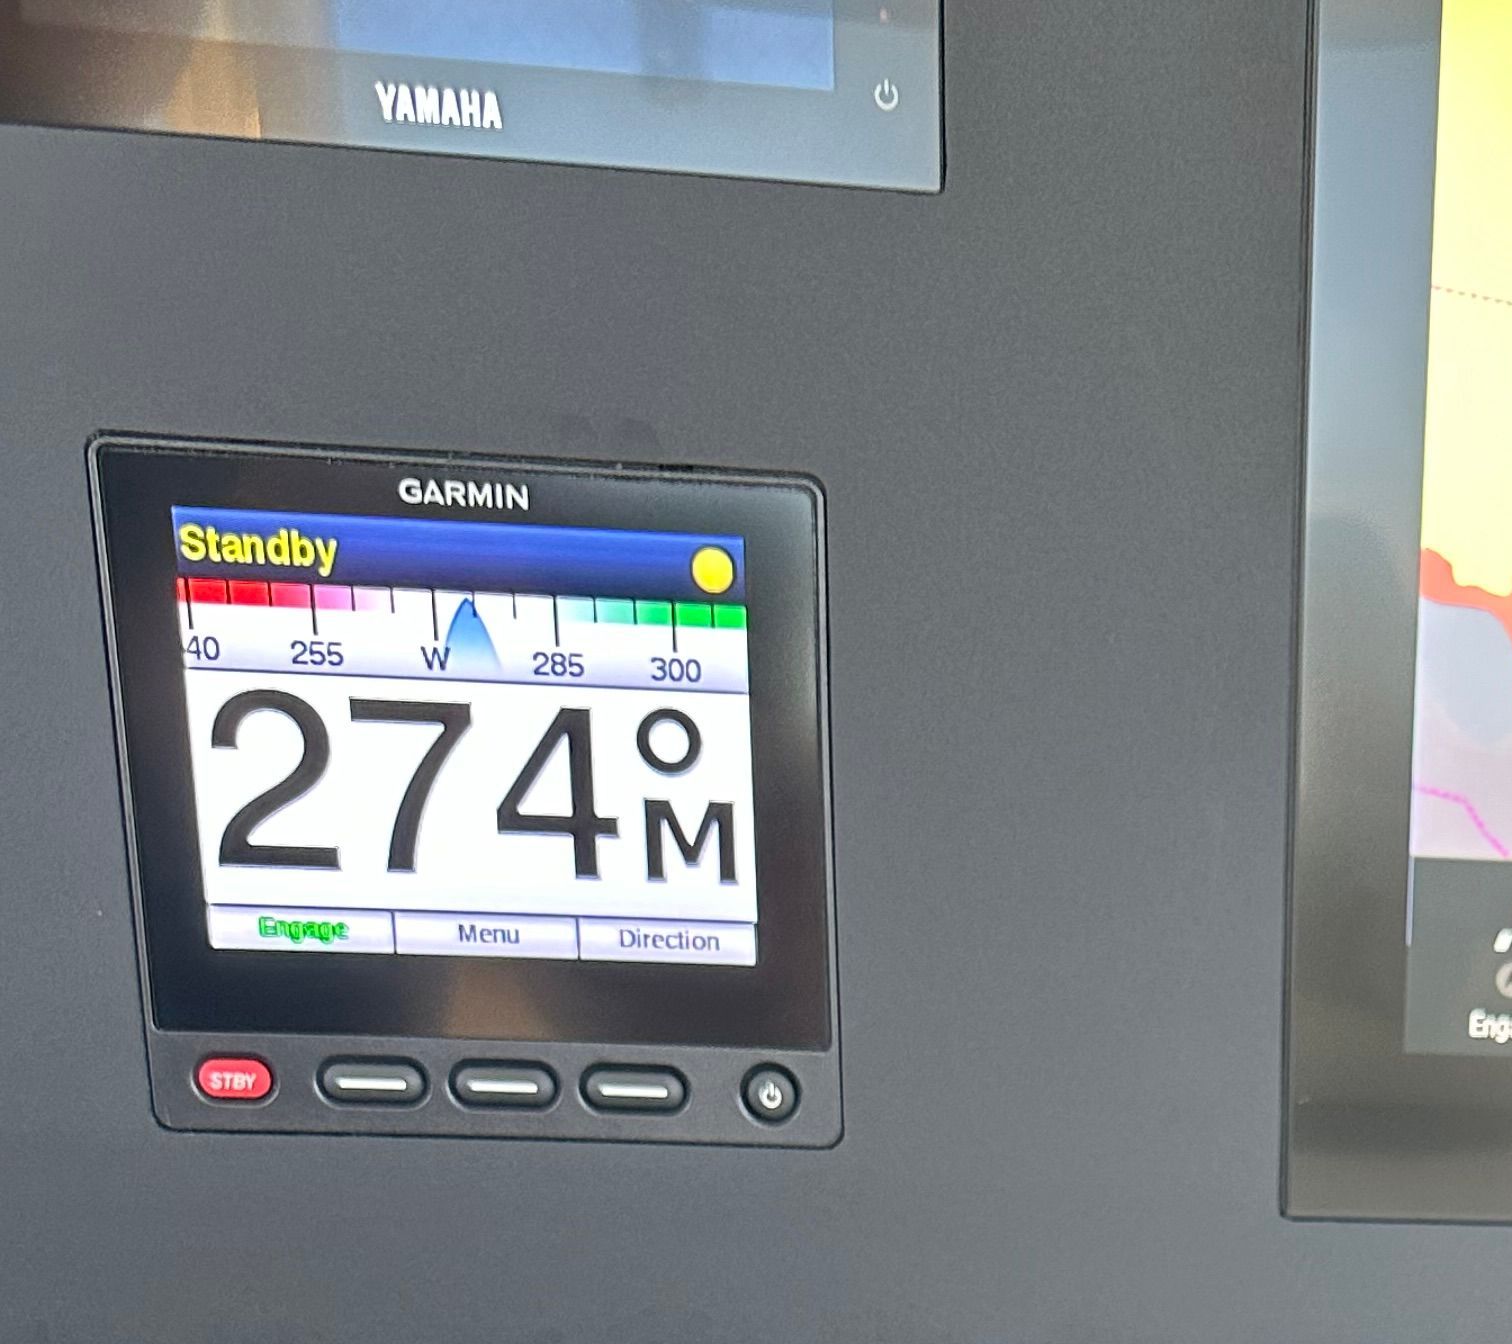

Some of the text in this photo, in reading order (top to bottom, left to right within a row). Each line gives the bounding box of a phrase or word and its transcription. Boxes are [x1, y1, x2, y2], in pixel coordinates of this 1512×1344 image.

[374, 81, 504, 130] YAMAHA
[398, 477, 531, 511] GARMIN
[179, 525, 338, 577] Standby
[290, 640, 344, 667] 255
[421, 646, 451, 672] W
[532, 652, 585, 678] 285
[650, 656, 702, 683] 300
[644, 799, 739, 884] M
[259, 914, 349, 945] Engage
[458, 922, 520, 945] Menu
[618, 927, 720, 953] Direction
[208, 1069, 257, 1091] STBY
